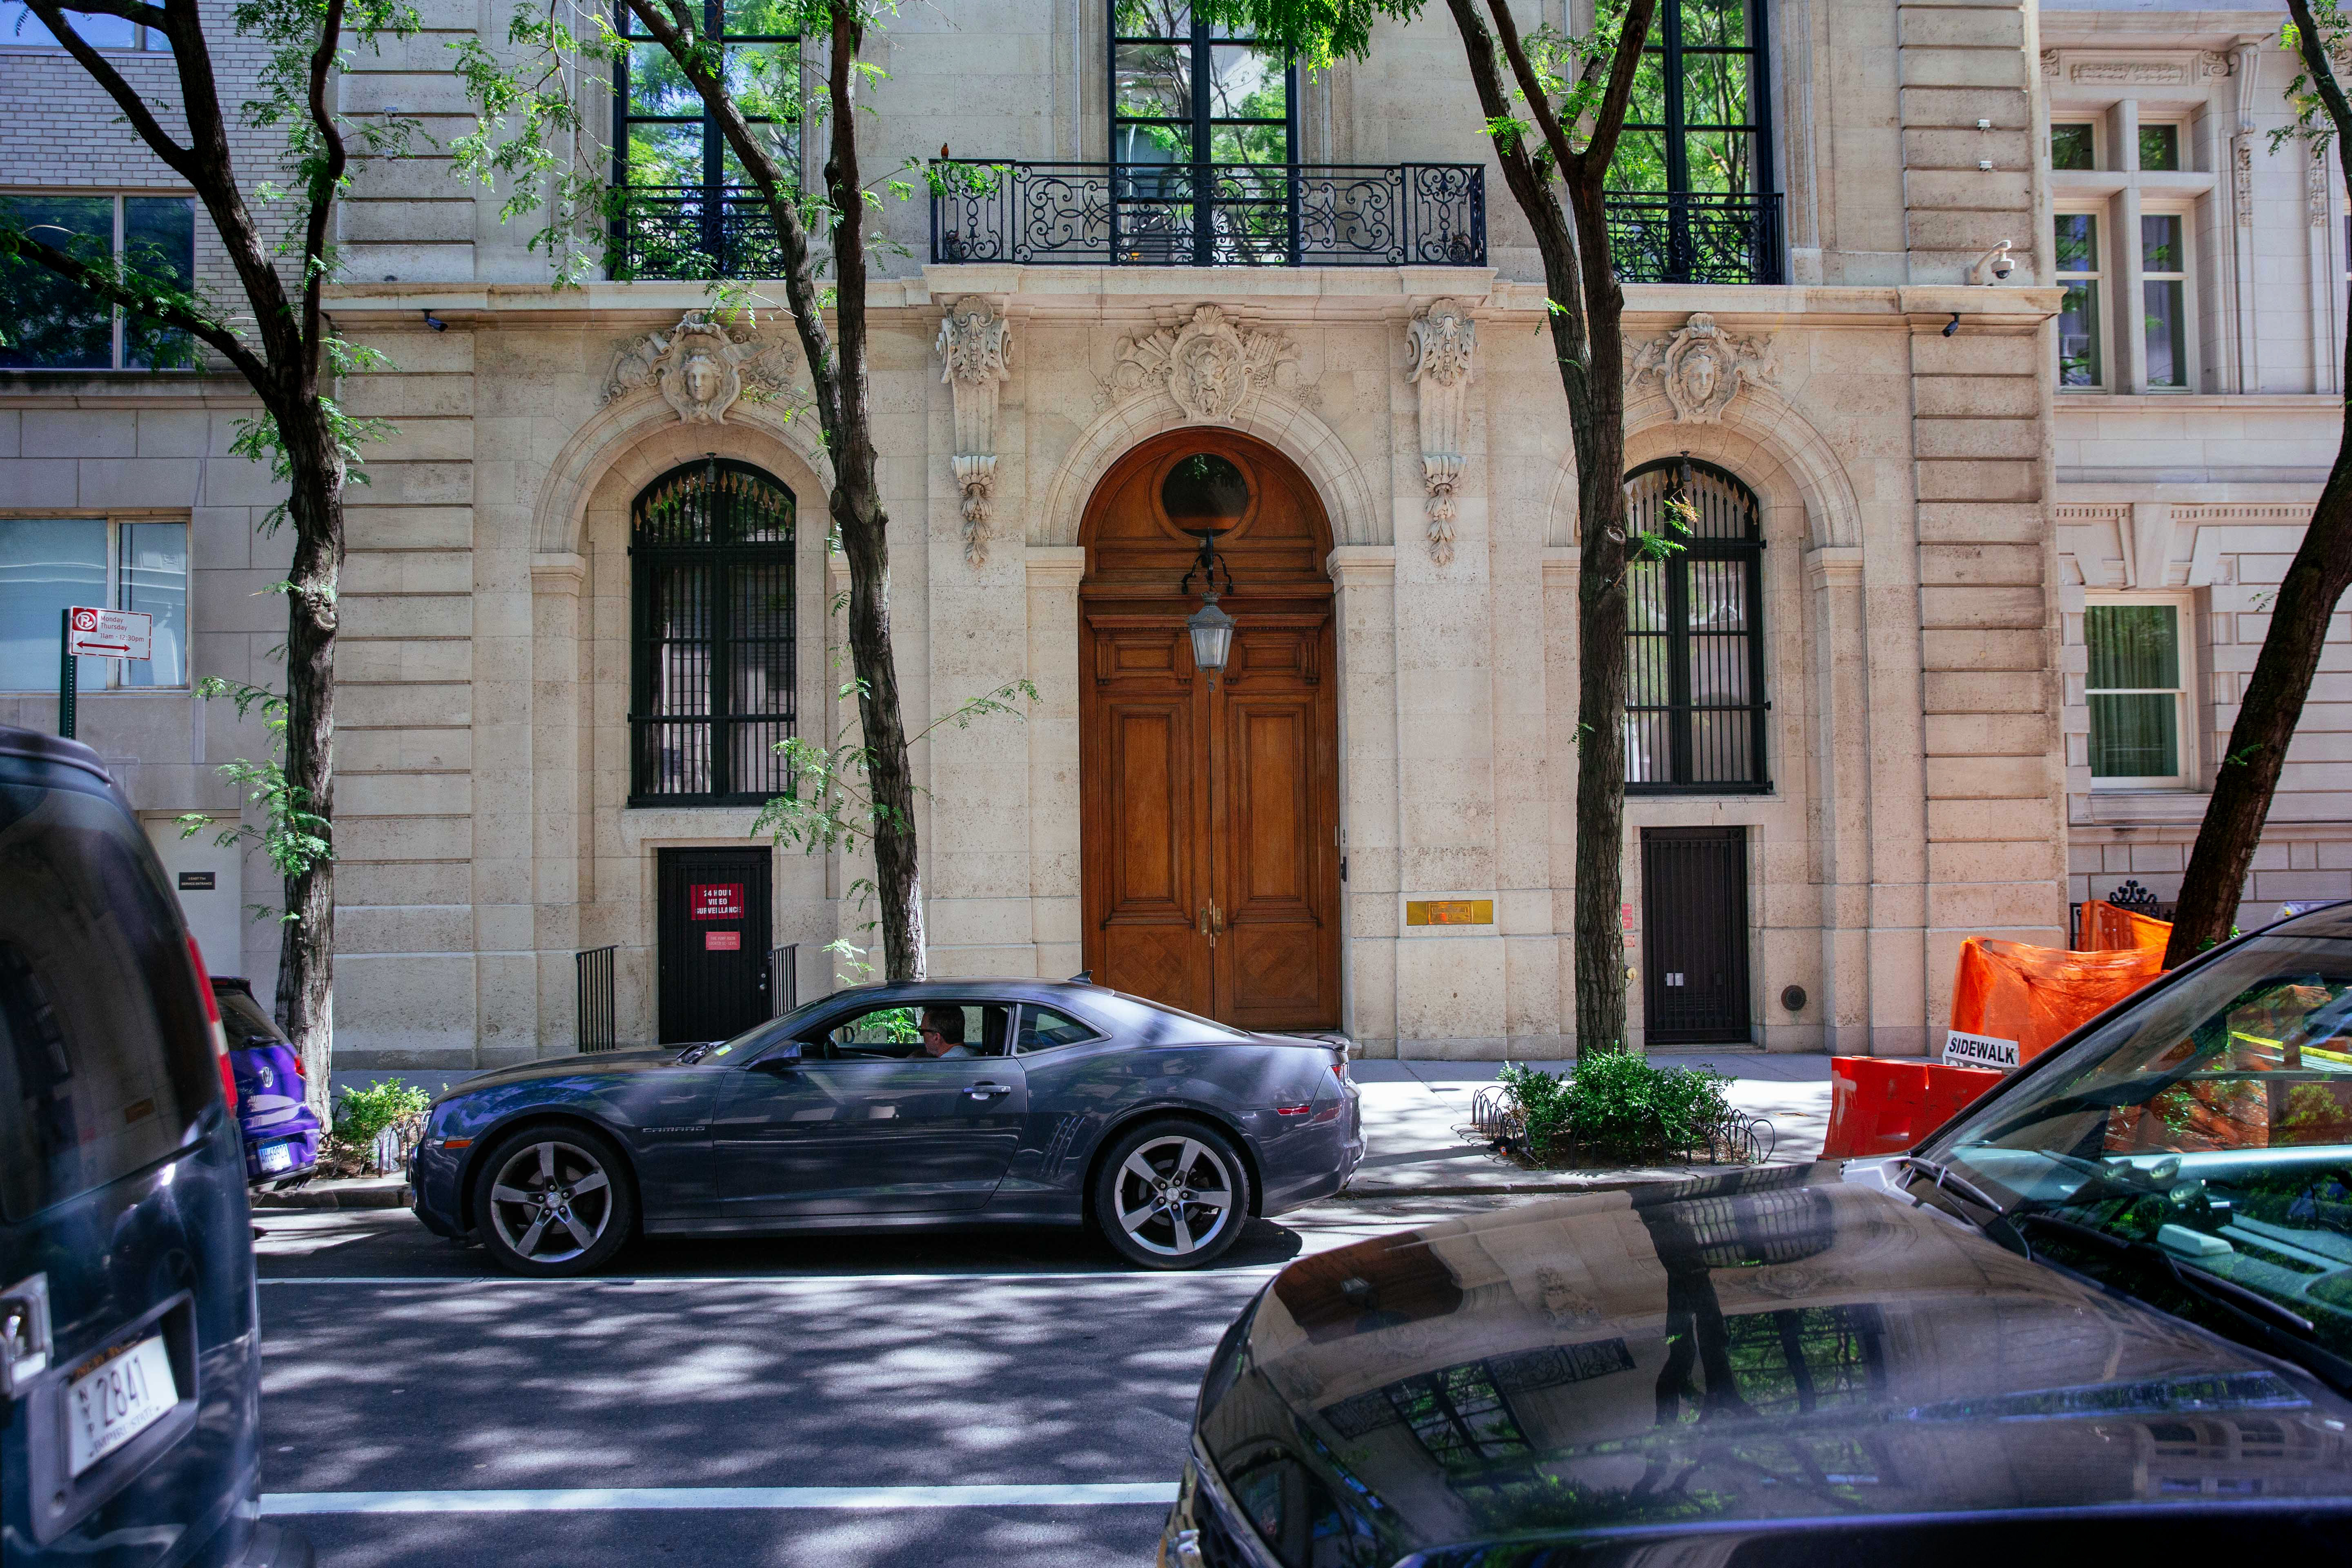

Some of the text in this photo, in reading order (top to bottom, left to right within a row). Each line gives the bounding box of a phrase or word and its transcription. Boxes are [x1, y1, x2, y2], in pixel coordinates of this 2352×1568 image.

[101, 623, 127, 631] Thursday
[120, 635, 144, 643] 12:30pm
[695, 906, 741, 914] SURVEILLANCE
[1949, 1037, 2015, 1064] SIDEWALK
